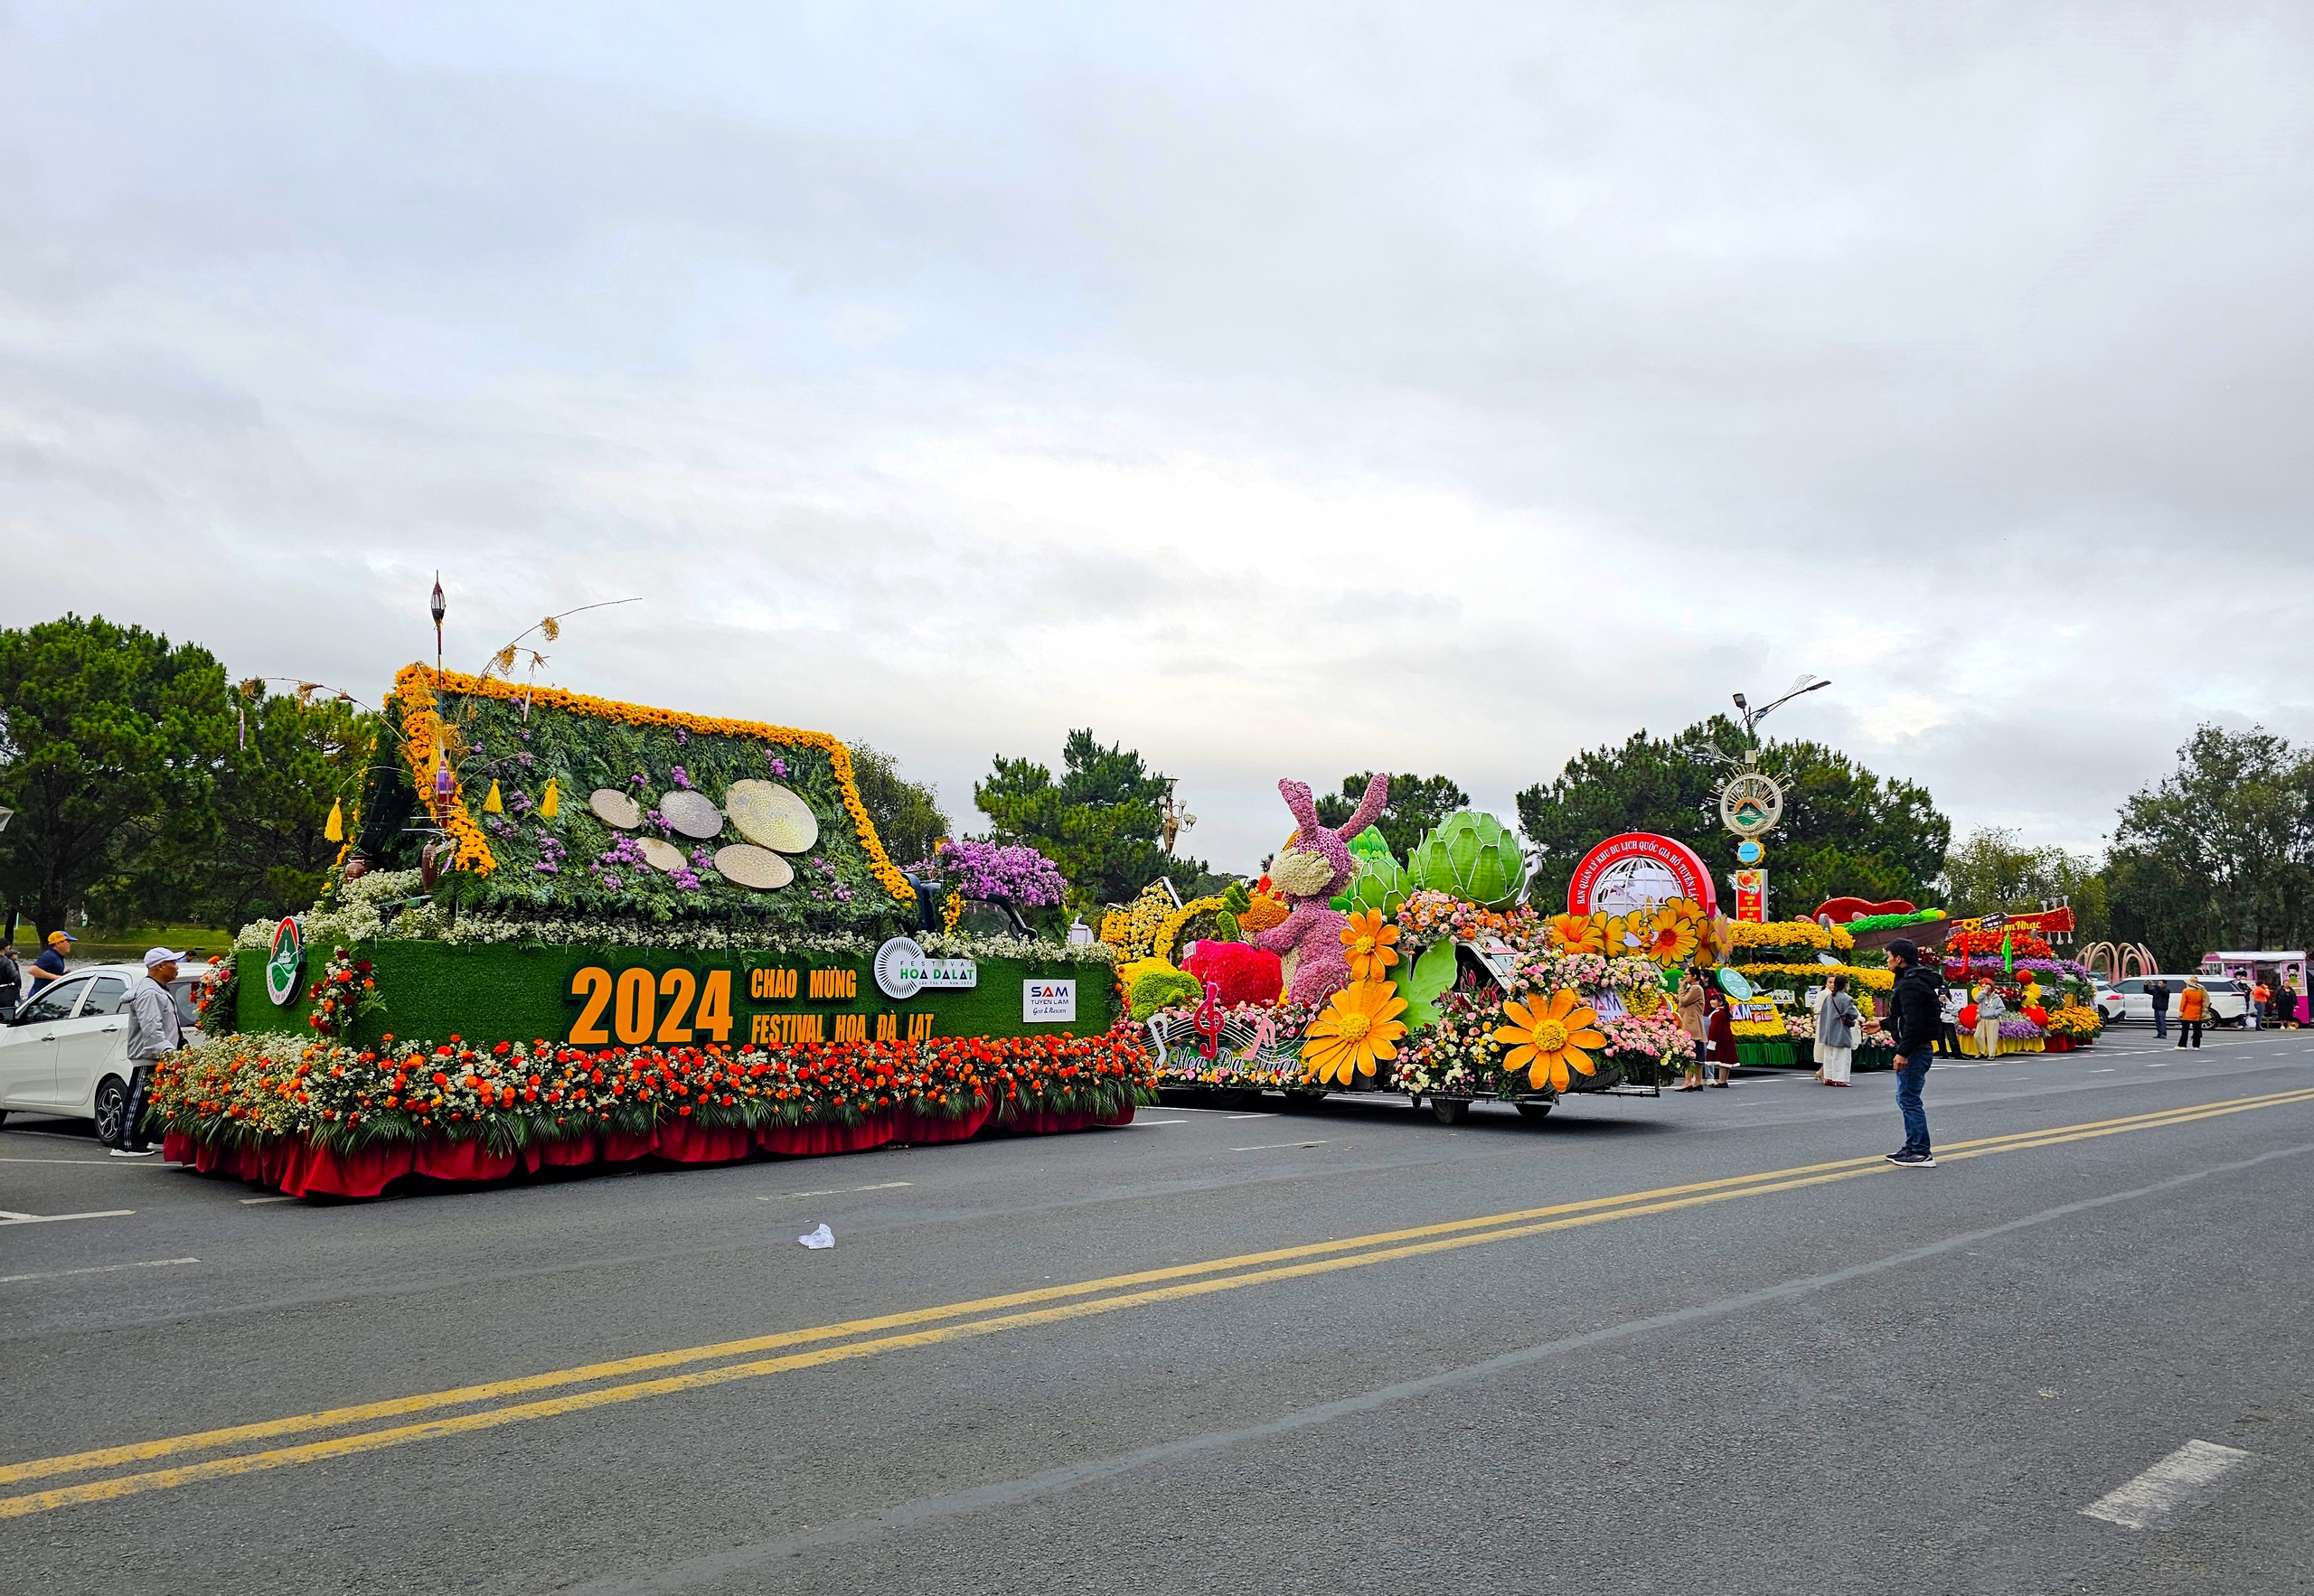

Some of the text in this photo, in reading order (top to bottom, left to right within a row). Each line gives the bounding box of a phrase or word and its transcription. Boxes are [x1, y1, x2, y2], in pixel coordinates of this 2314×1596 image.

[1577, 890, 1585, 904] BAN
[1596, 850, 1611, 863] KHU
[1610, 844, 1620, 854] DU
[1621, 841, 1637, 851] LỊCH
[1640, 840, 1659, 852] QUỐC
[1658, 848, 1670, 859] GIA
[751, 965, 857, 999] CHÀO MỪNG
[900, 969, 974, 980] HOA DALAT
[1030, 986, 1068, 997] SAM
[1590, 992, 1623, 1011] AM
[569, 966, 733, 1045] 2024
[1731, 1003, 1753, 1020] AM
[751, 1014, 824, 1044] FESTIVAL
[834, 1014, 867, 1043] HOA
[877, 1009, 897, 1041] ĐÀ
